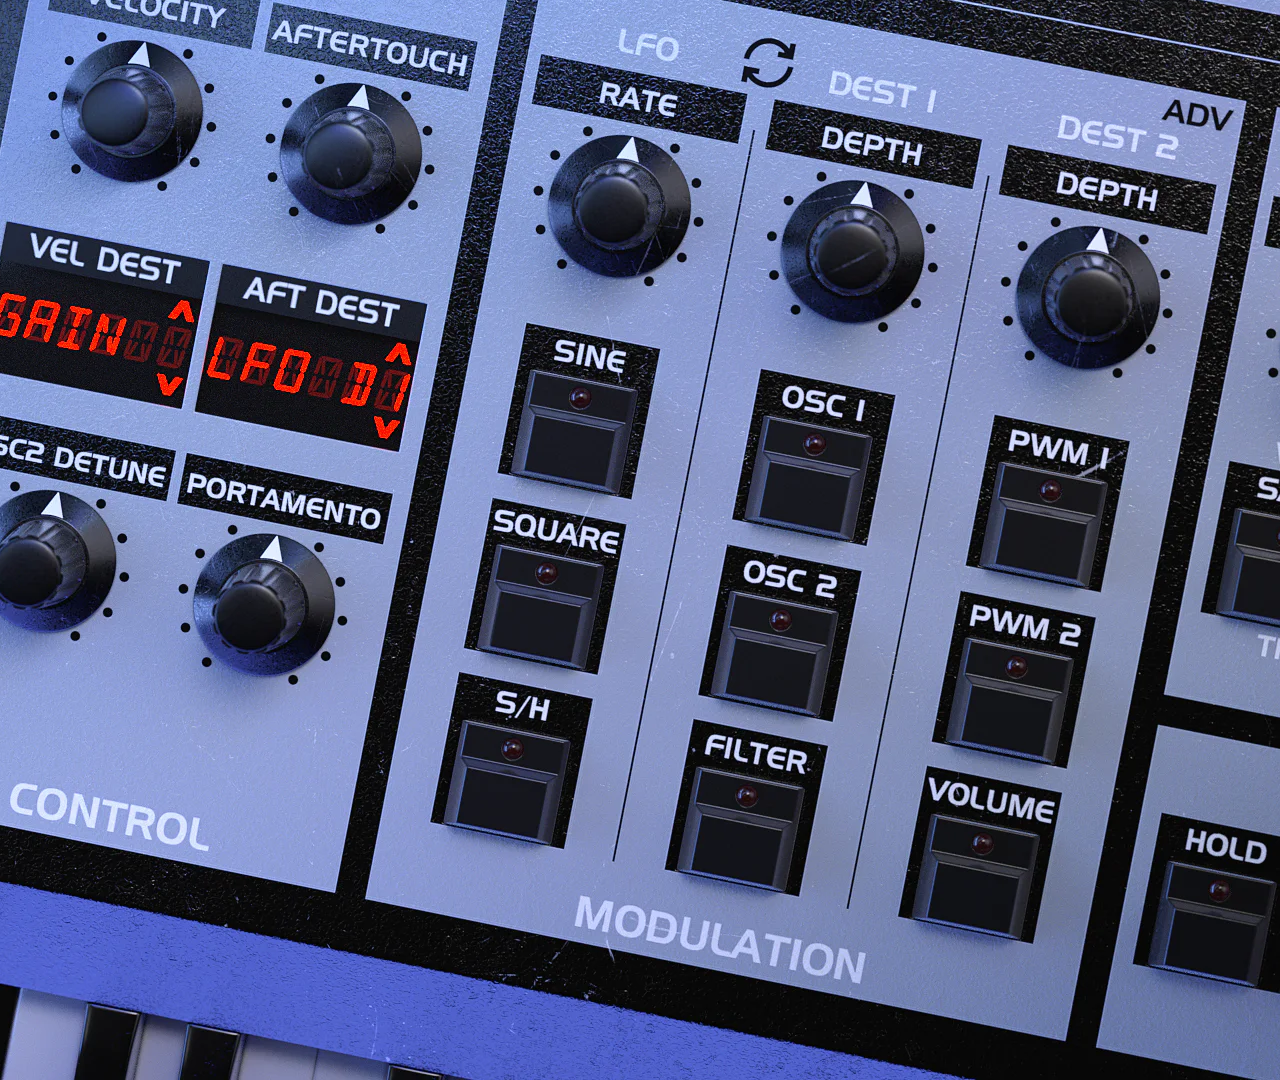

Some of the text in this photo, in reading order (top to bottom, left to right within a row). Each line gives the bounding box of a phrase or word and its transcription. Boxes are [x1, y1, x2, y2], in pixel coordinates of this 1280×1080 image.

[271, 19, 469, 78] AFTERTOUCH
[617, 28, 680, 62] LFO
[598, 81, 679, 118] RATE
[828, 70, 937, 114] DEST 1
[1161, 99, 1234, 132] ADV
[821, 125, 923, 166] DEPTH
[1056, 114, 1180, 161] DEST 2
[1056, 170, 1159, 212] DEPTH
[30, 232, 182, 285] VEL DEST
[242, 276, 401, 328] AFT DEST
[206, 336, 312, 394] LFO
[553, 339, 627, 375] SINE
[781, 385, 866, 422] OSC 1
[52, 445, 167, 488] DETUNE
[1008, 428, 1111, 471] PWM 1
[186, 472, 382, 531] PORTAMENTO
[492, 509, 620, 555] SQUARE
[743, 560, 838, 599] OSC 2
[969, 604, 1082, 648] PWM 2
[494, 690, 551, 722] S/H
[704, 733, 808, 775] FILTER
[9, 782, 210, 852] CONTROL
[928, 776, 1056, 824] VOLUME
[1185, 828, 1268, 865] HOLD
[574, 895, 867, 984] MODULATION
